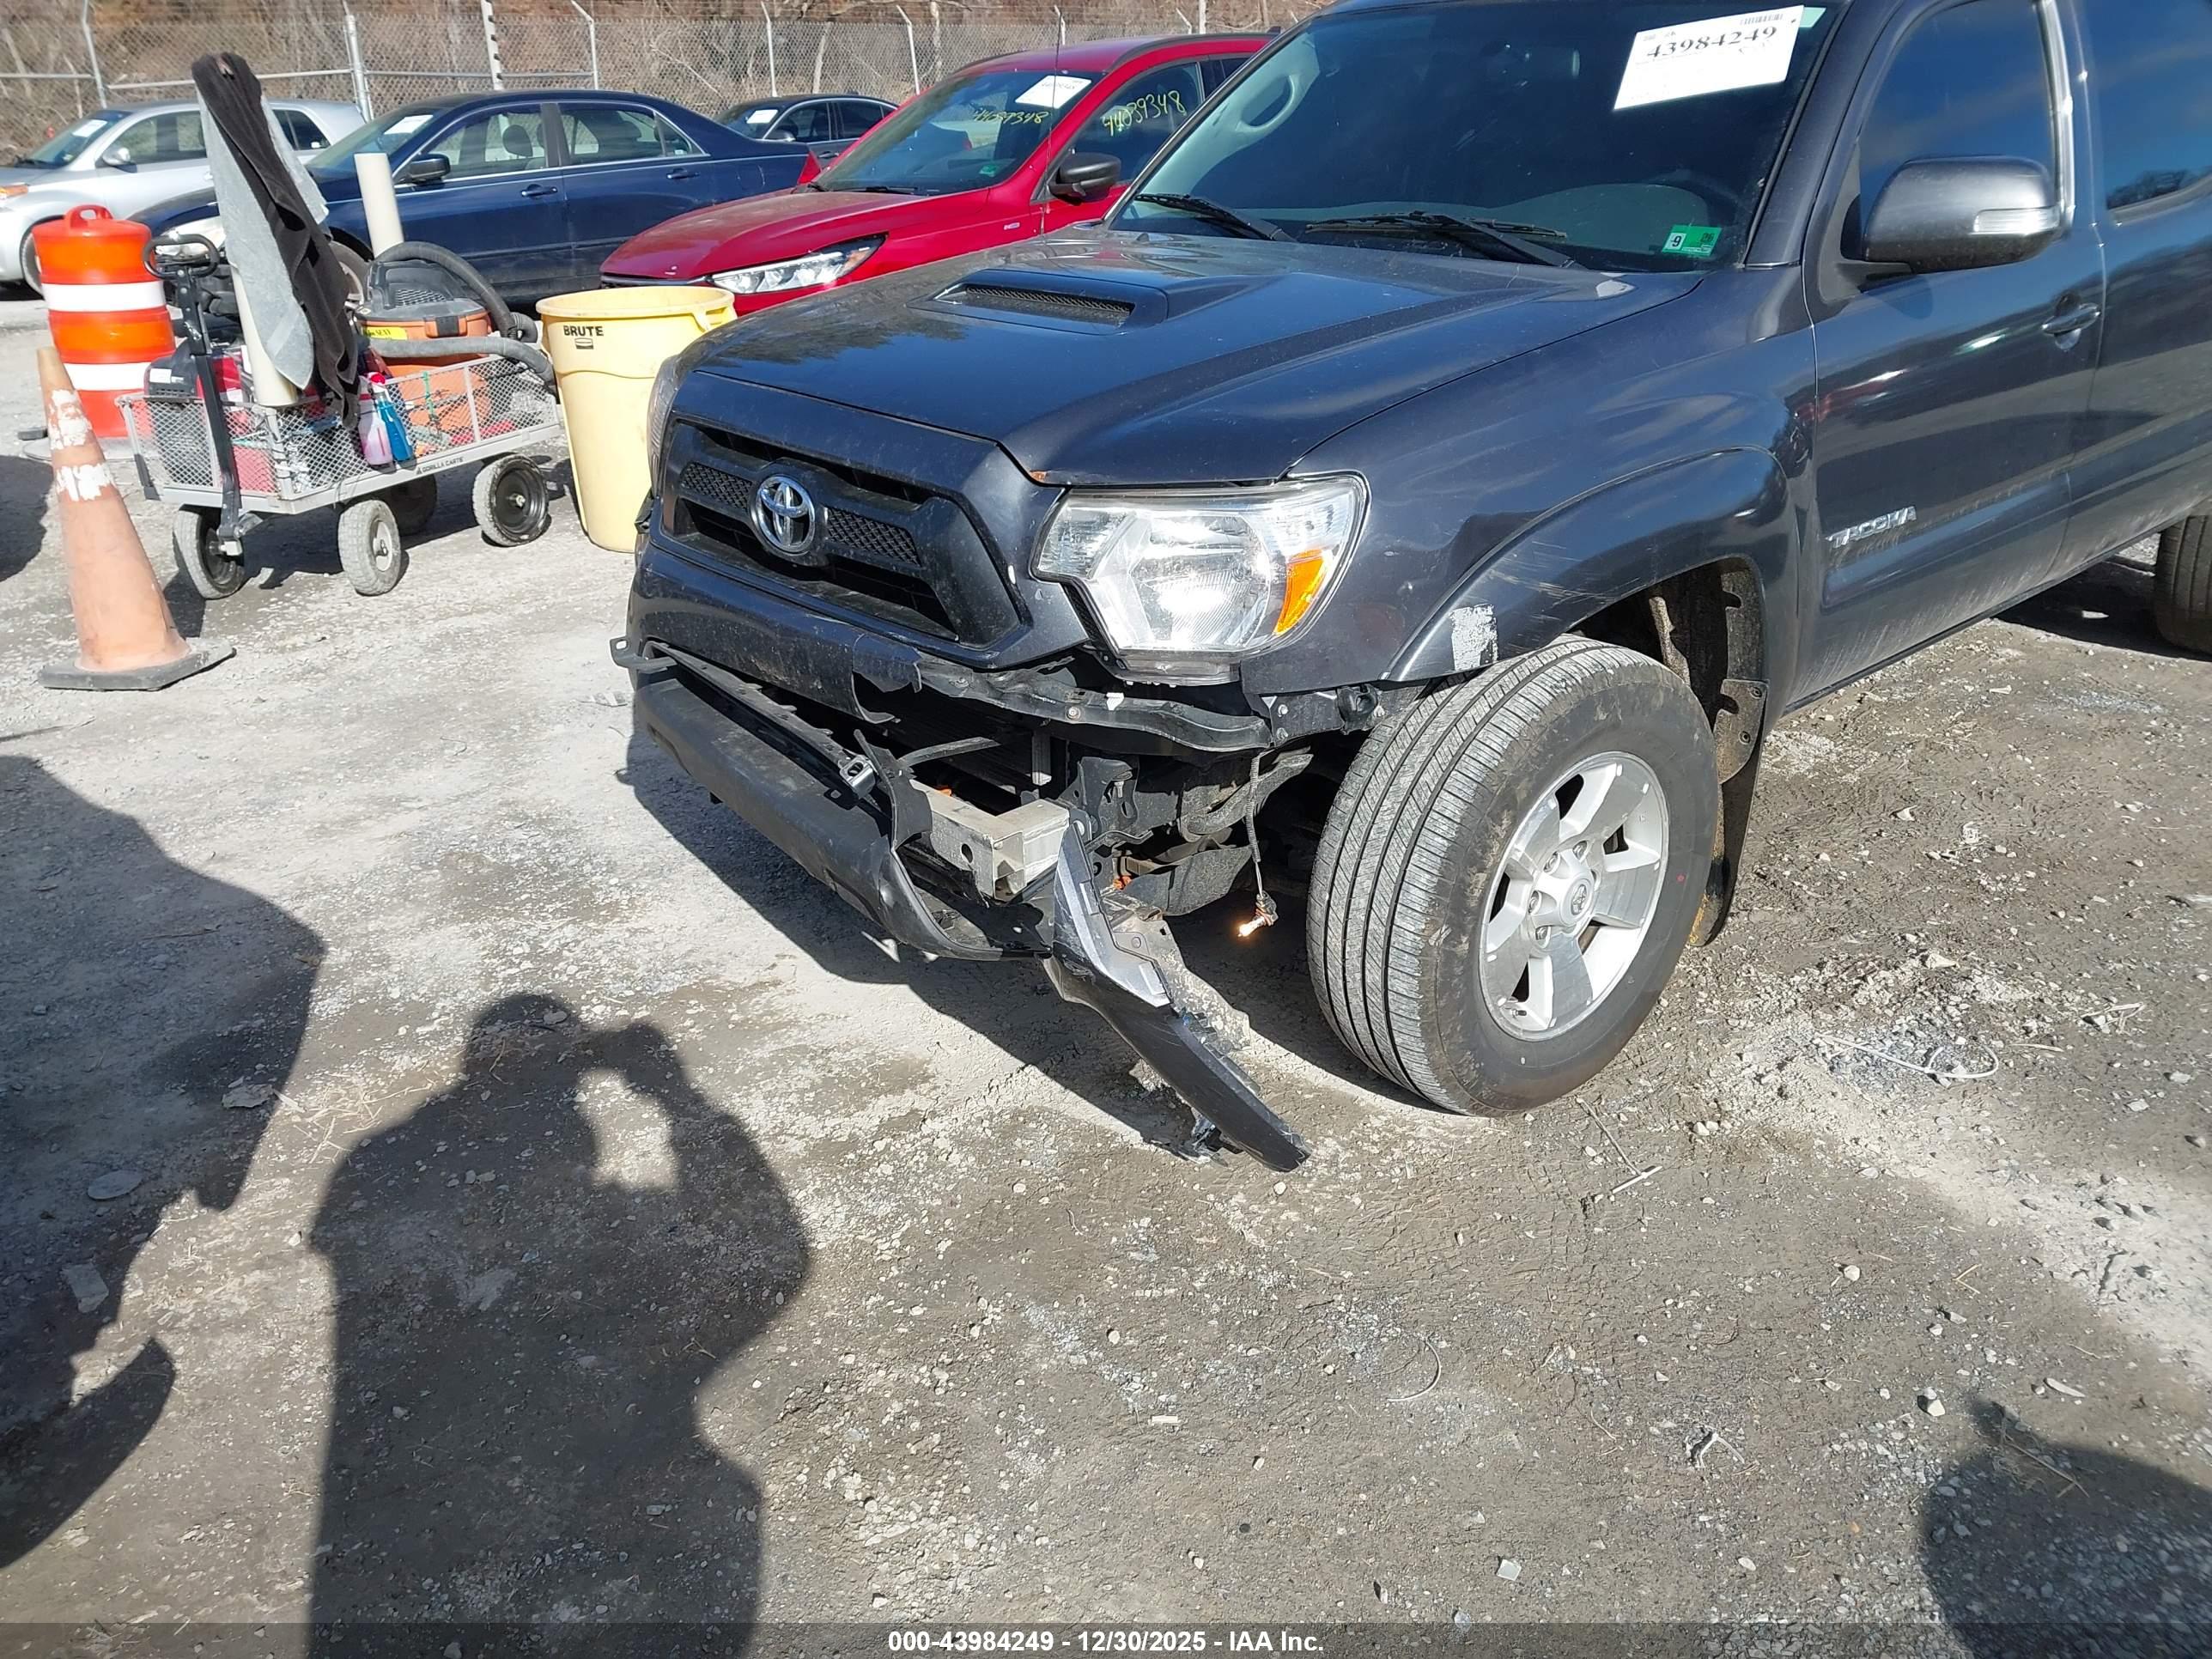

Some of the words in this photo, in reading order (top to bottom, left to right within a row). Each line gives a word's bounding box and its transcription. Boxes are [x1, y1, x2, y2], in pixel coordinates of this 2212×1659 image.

[1646, 26, 1778, 58] 43984249
[1102, 89, 1187, 137] 44039348
[562, 325, 604, 337] BRUTE
[1825, 506, 1917, 549] TACOMA
